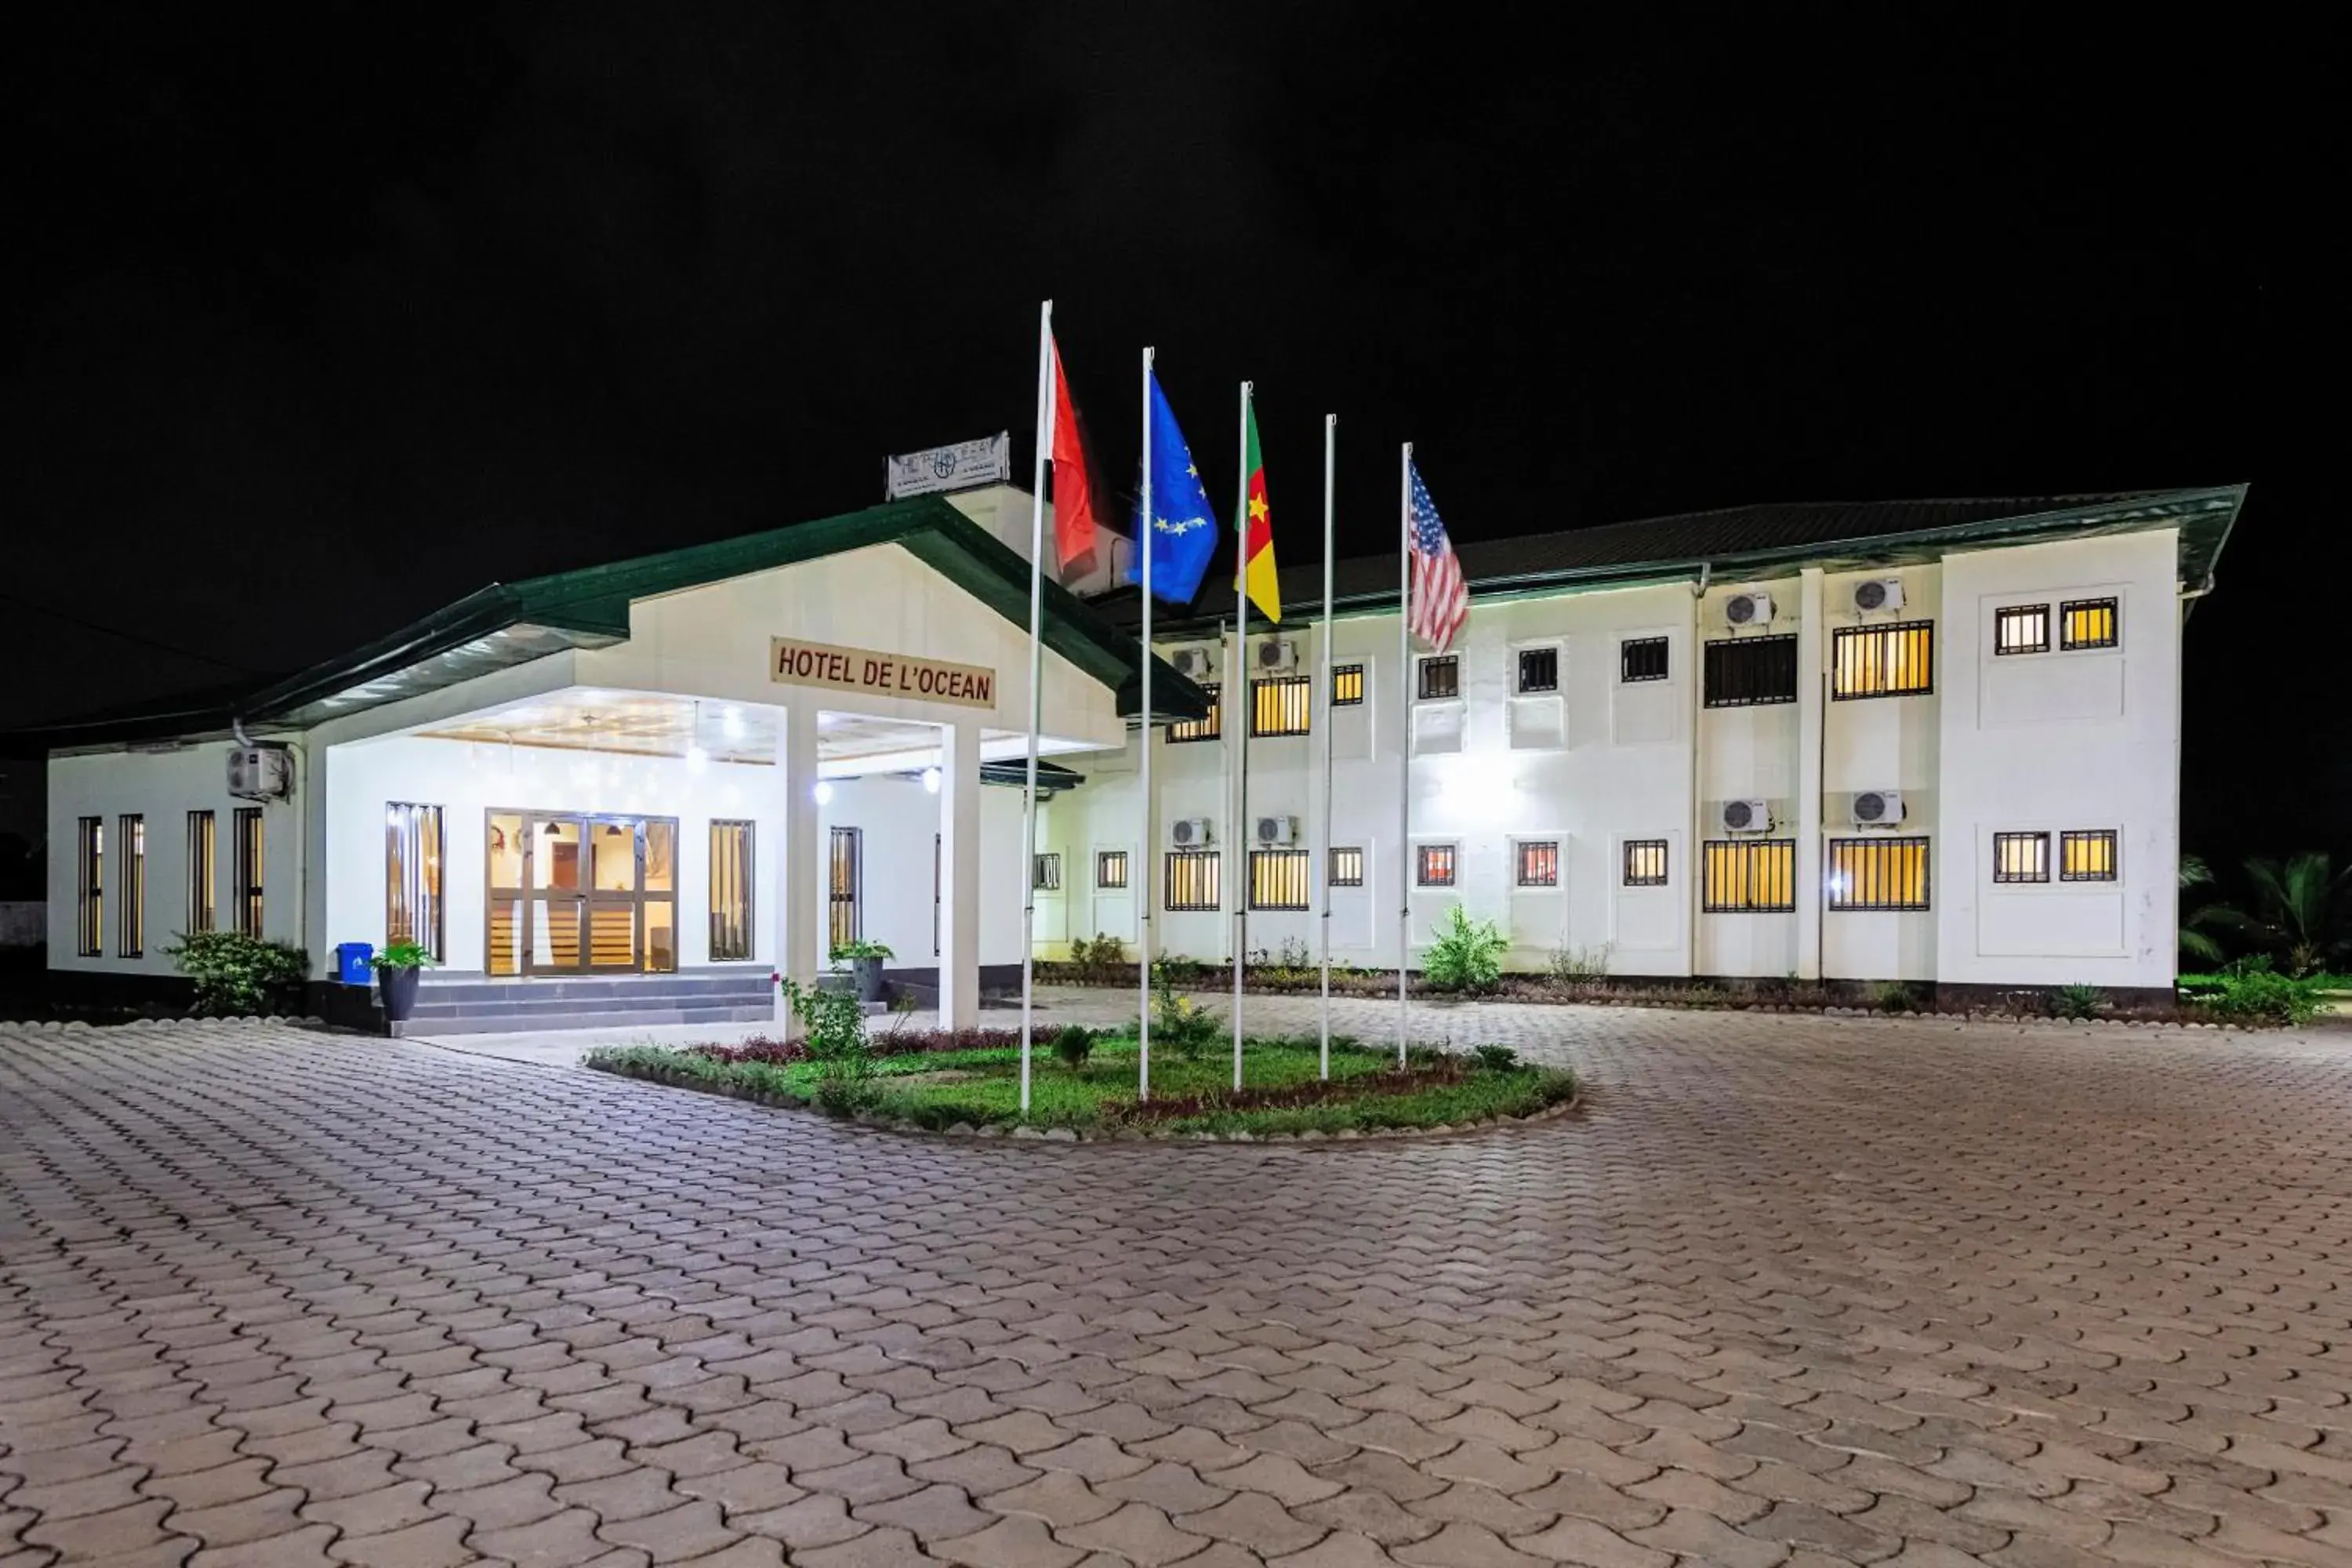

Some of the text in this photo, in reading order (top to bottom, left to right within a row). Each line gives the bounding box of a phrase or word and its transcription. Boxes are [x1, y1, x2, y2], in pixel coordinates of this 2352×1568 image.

[779, 647, 990, 701] HOTEL DE L'OCEAN
